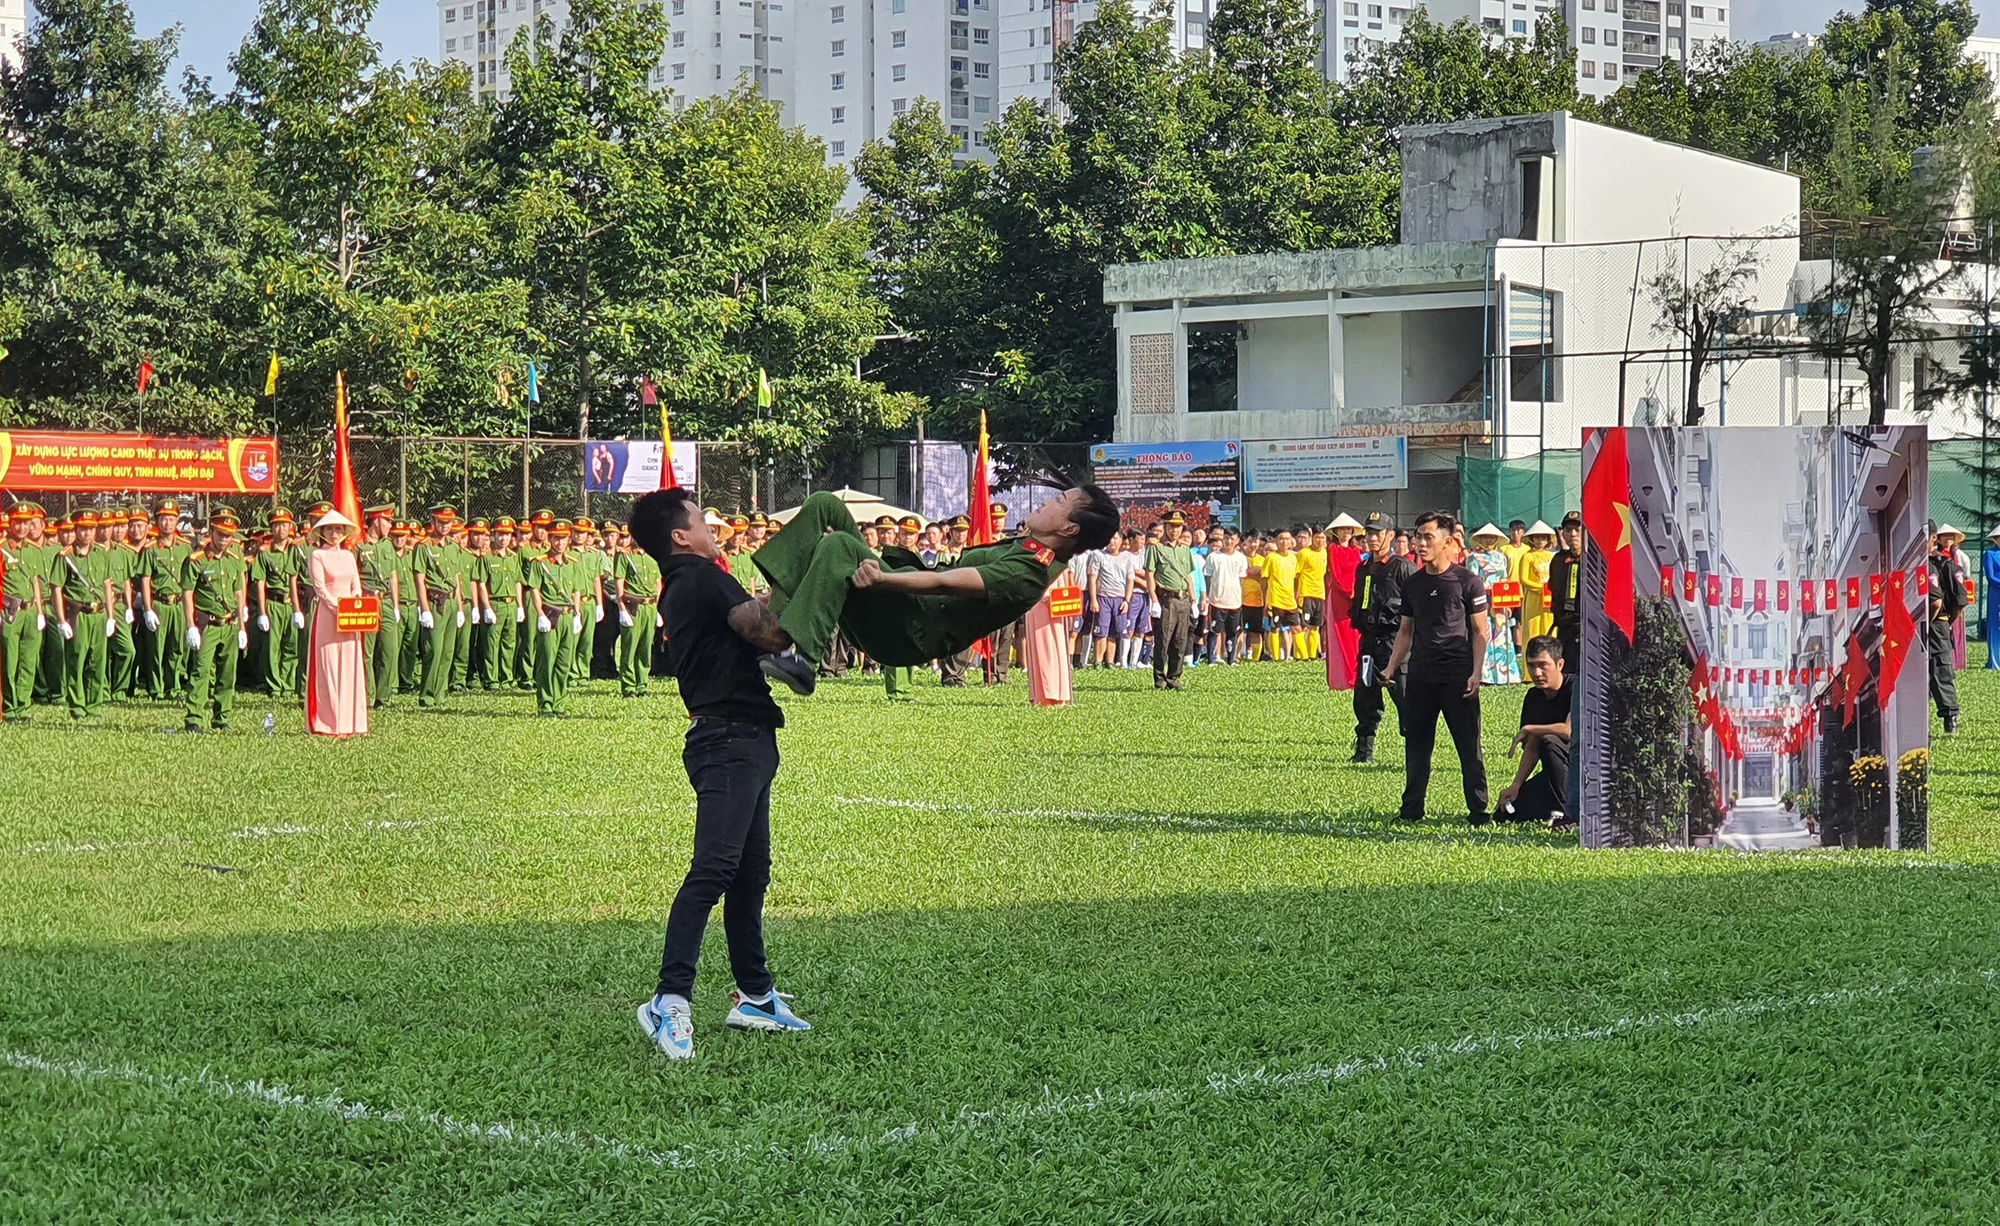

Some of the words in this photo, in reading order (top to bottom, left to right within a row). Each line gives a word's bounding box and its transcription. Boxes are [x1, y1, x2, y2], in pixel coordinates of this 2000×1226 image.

[15, 443, 32, 456] XÂY
[34, 445, 59, 459] DỰNG
[61, 446, 78, 460] LỰC
[80, 446, 109, 460] LƯỢNG
[111, 447, 135, 458] CAND
[171, 449, 199, 460] TRONG
[1171, 450, 1193, 462] BÁO
[29, 462, 54, 475] VỮNG
[56, 465, 84, 478] MẠNH,
[85, 463, 112, 477] CHÍNH
[113, 466, 133, 479] QUY,
[135, 466, 153, 477] TINH
[155, 465, 178, 480] NHUỆ,
[180, 465, 198, 480] HIỆN
[200, 468, 214, 481] ĐẠI
